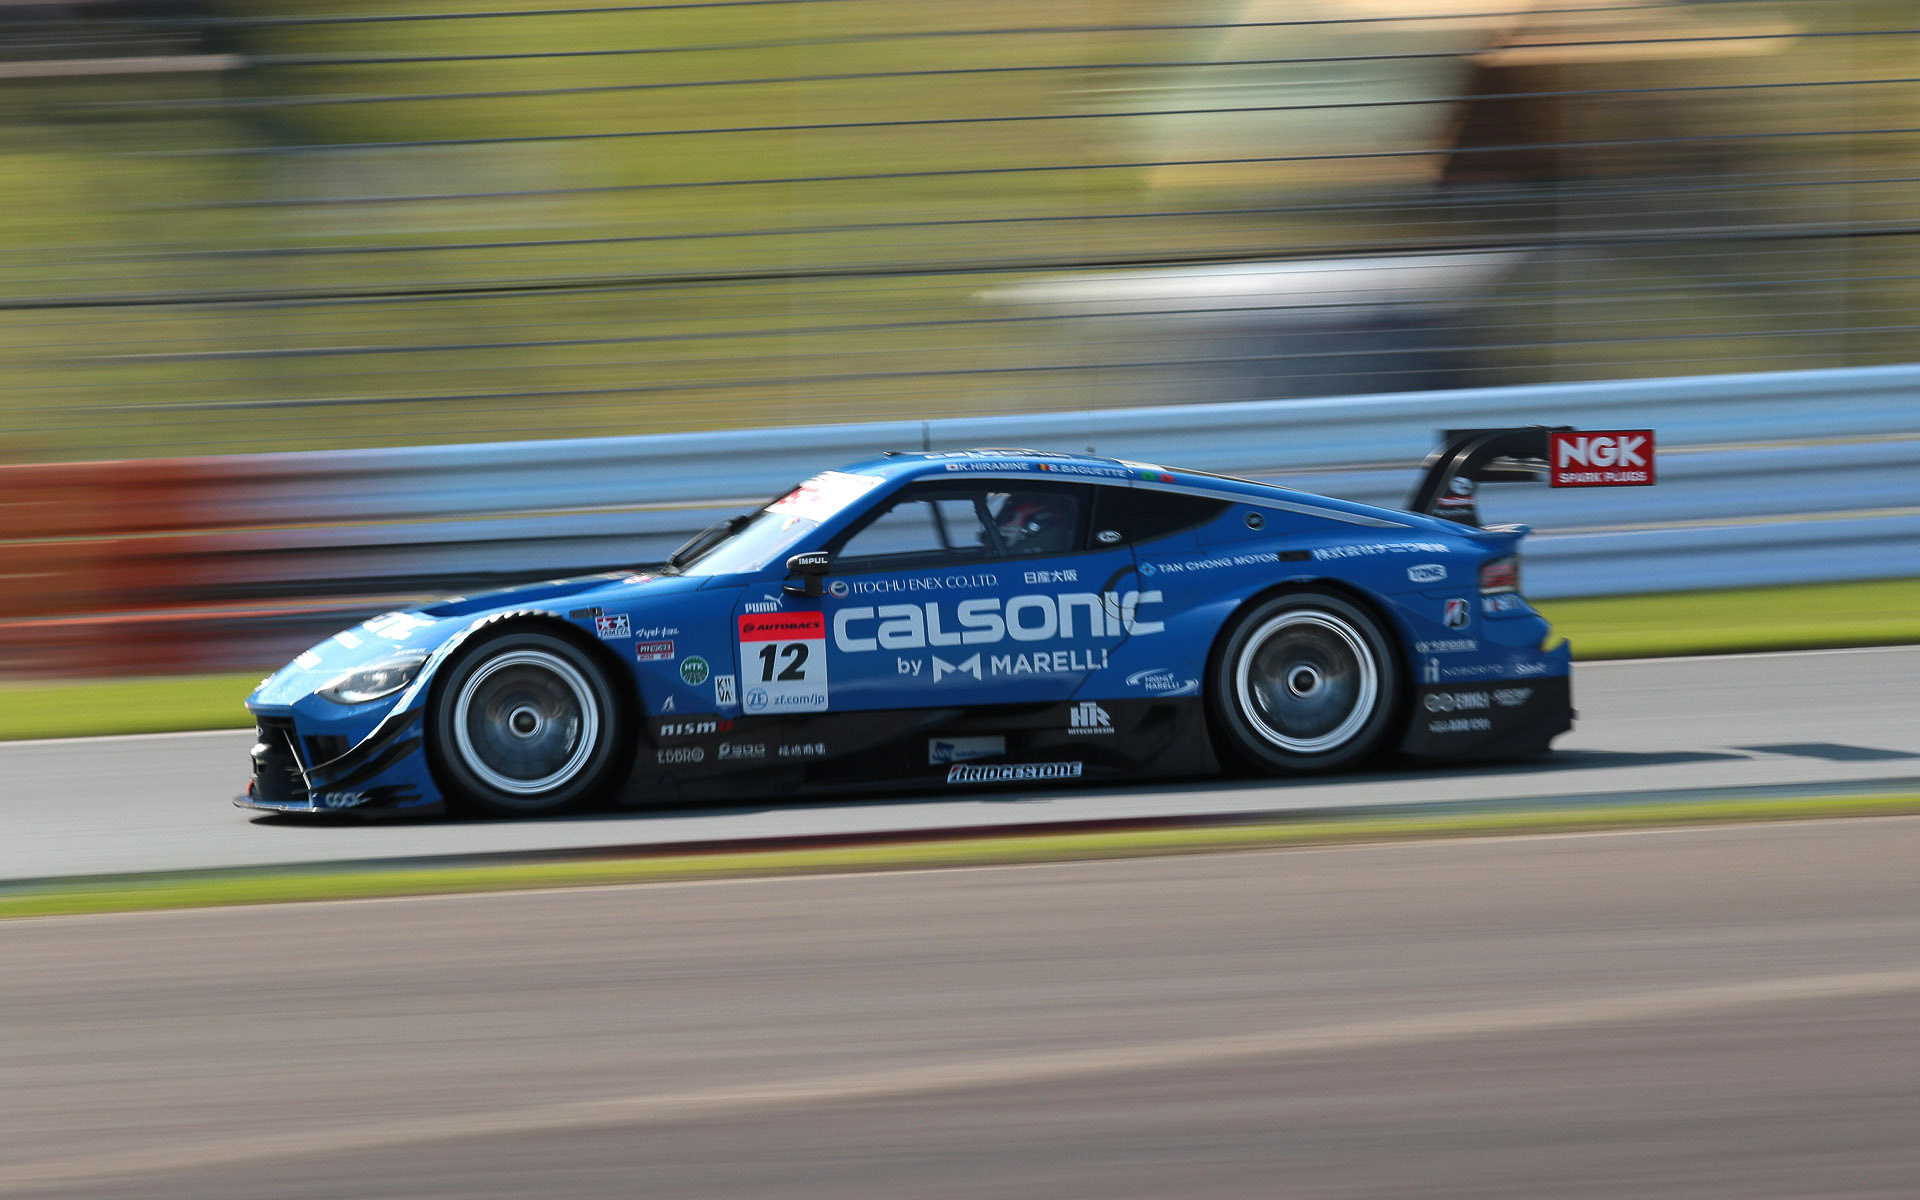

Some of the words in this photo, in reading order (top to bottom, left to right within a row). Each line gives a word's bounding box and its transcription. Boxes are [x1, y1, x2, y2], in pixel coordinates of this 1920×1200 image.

[1557, 435, 1647, 468] NGK
[958, 462, 1030, 472] K.HIRAMINE
[1049, 464, 1128, 478] B.BAGUETTE
[1558, 472, 1602, 483] SPARK
[1605, 471, 1648, 482] PLUGS
[799, 557, 828, 565] IMPUL
[1157, 563, 1184, 573] TAN
[1185, 558, 1233, 571] CHONG
[1234, 553, 1280, 566] MOTOR
[1024, 569, 1078, 585] 日産大阪
[853, 579, 906, 594] ITOCHU
[909, 577, 943, 591] ENEX
[745, 602, 777, 613] PUMA
[757, 622, 820, 631] AUTOBACS
[759, 643, 809, 682] 12
[897, 657, 922, 676] by
[991, 648, 1108, 676] MARELLI
[774, 693, 825, 705] zf.com/jp
[947, 762, 1083, 783] BRIDGESTONE
